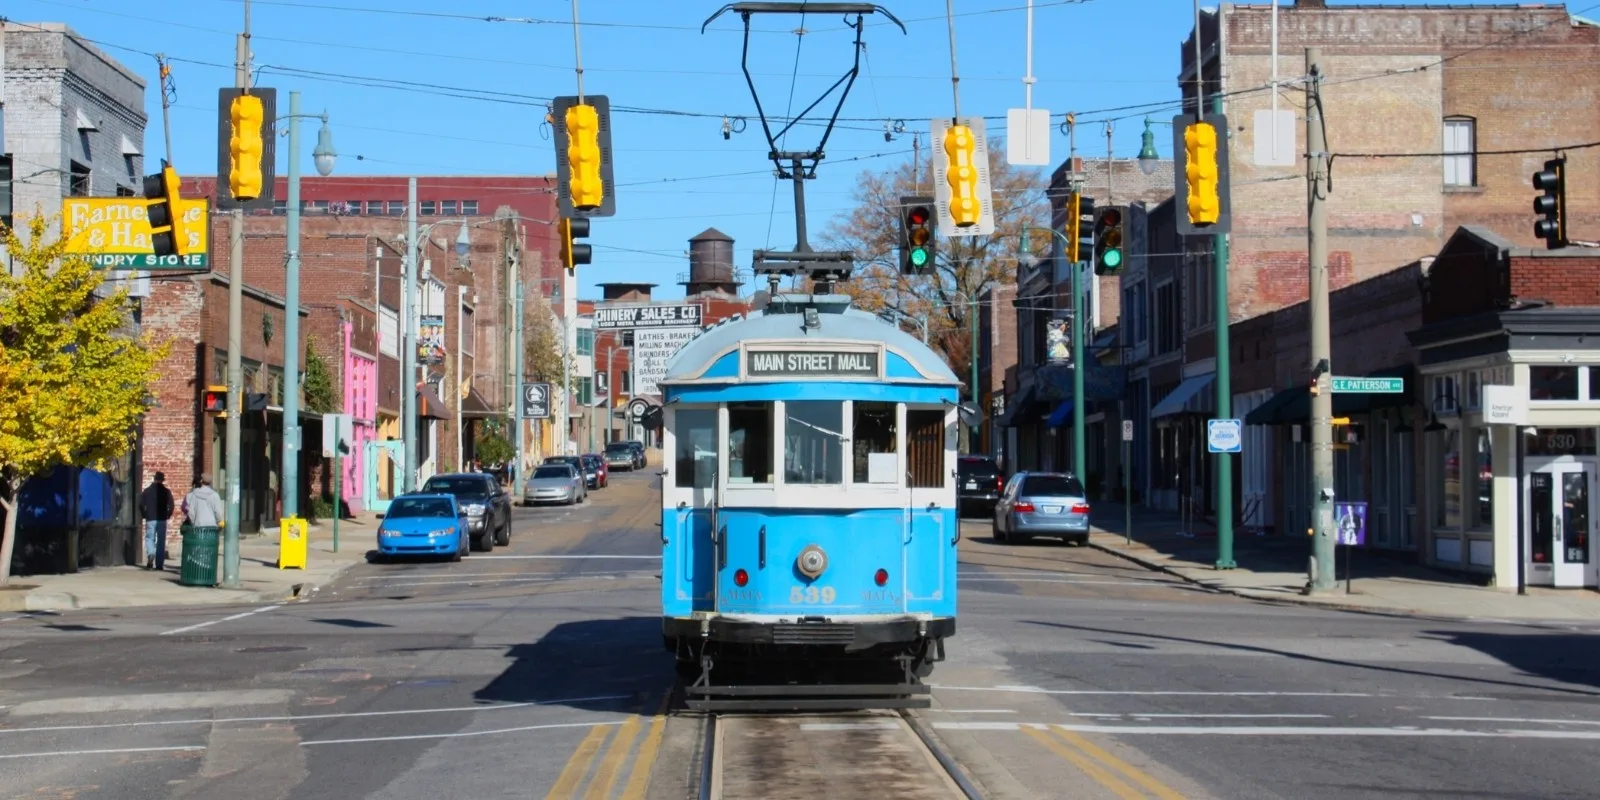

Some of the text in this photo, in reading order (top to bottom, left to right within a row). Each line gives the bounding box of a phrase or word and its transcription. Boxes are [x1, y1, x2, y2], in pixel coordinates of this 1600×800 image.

[89, 222, 199, 249] & Ha's
[641, 307, 675, 320] SALES
[681, 306, 699, 319] CO.
[639, 341, 663, 349] MILLING
[754, 354, 871, 371] MAIN STREET MALL
[1347, 380, 1391, 390] PATTERSON
[1547, 434, 1575, 448] 530
[788, 586, 837, 604] 539
